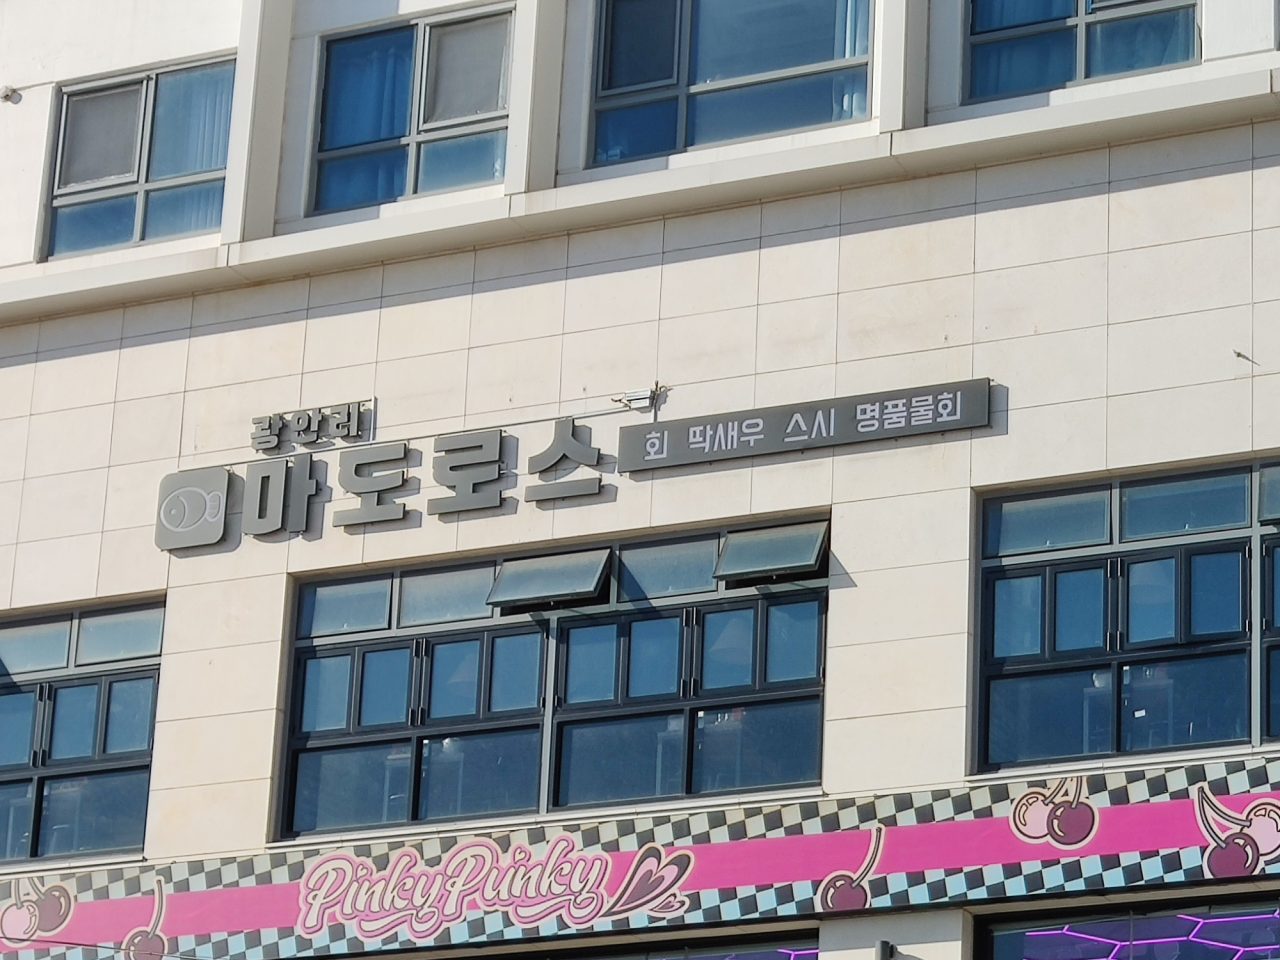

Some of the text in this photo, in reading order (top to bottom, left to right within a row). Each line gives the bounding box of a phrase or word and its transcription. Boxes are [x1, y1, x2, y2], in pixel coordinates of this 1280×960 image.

[251, 402, 360, 452] 광안리
[643, 391, 962, 461] 회 딱새우 스시 명품물회
[241, 416, 601, 535] 마도로스
